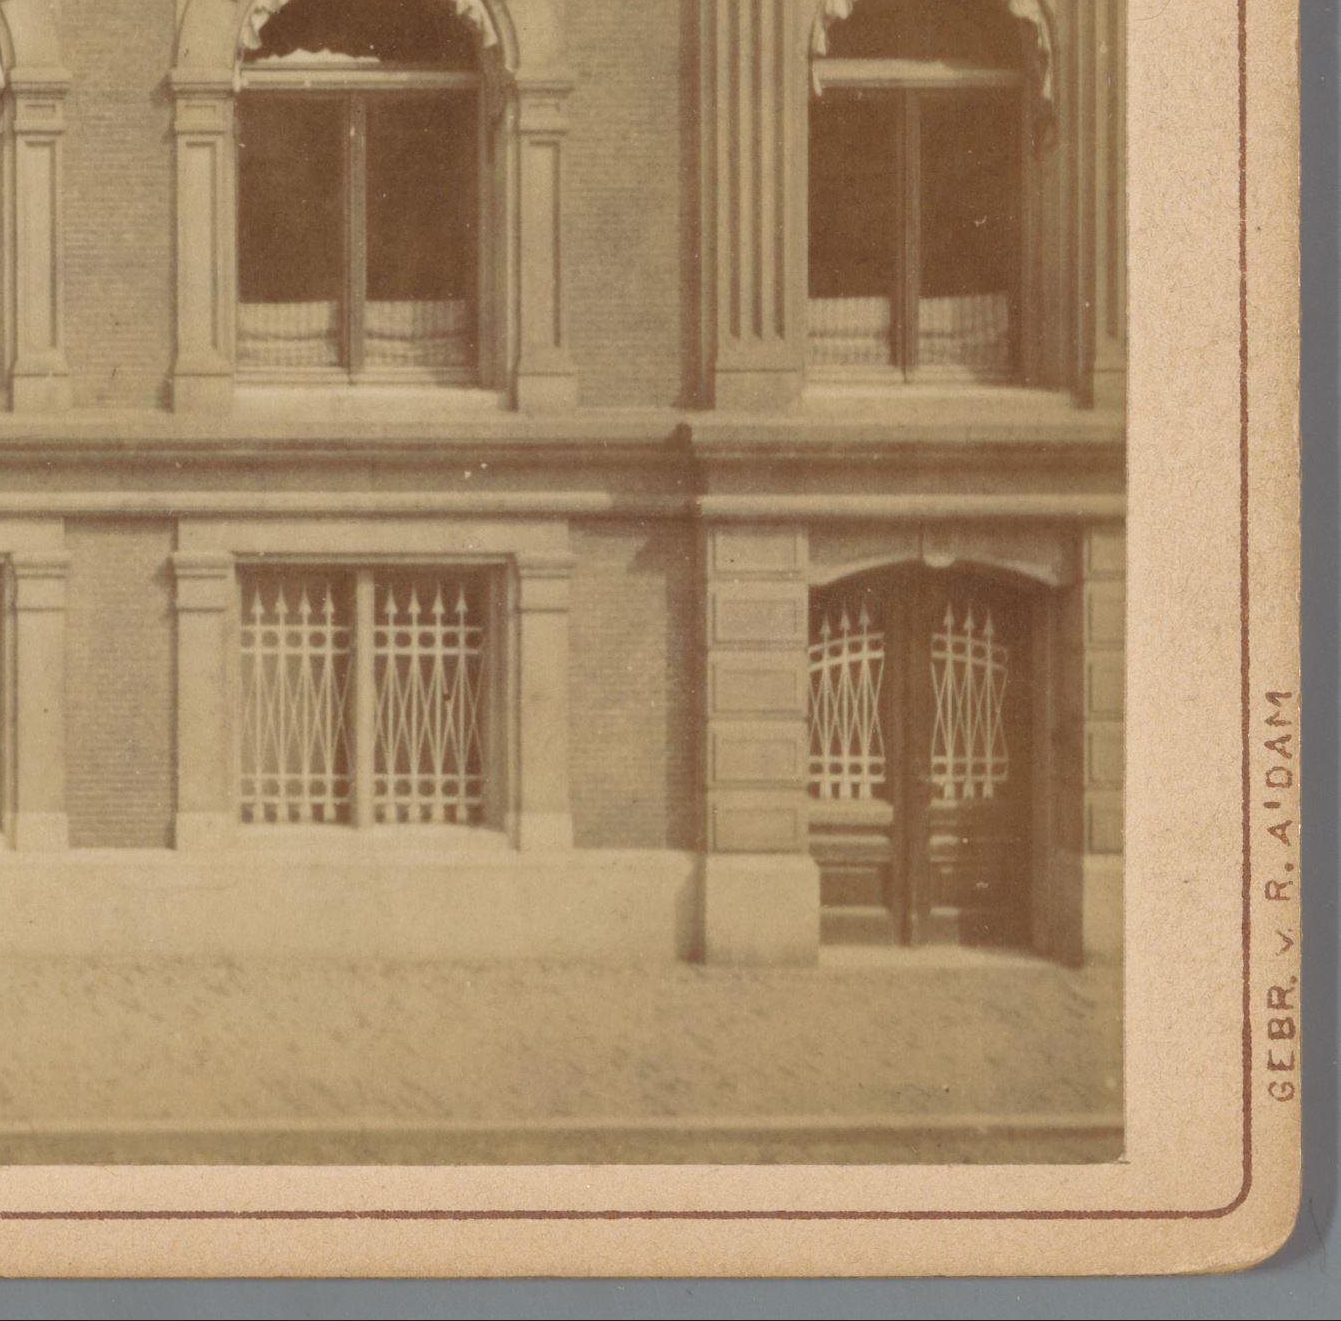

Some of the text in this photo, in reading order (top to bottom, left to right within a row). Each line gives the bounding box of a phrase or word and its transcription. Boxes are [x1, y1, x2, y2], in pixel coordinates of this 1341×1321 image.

[1264, 690, 1294, 847] A'DAM
[1264, 862, 1295, 902] R.
[1266, 975, 1298, 1103] GEBR.
